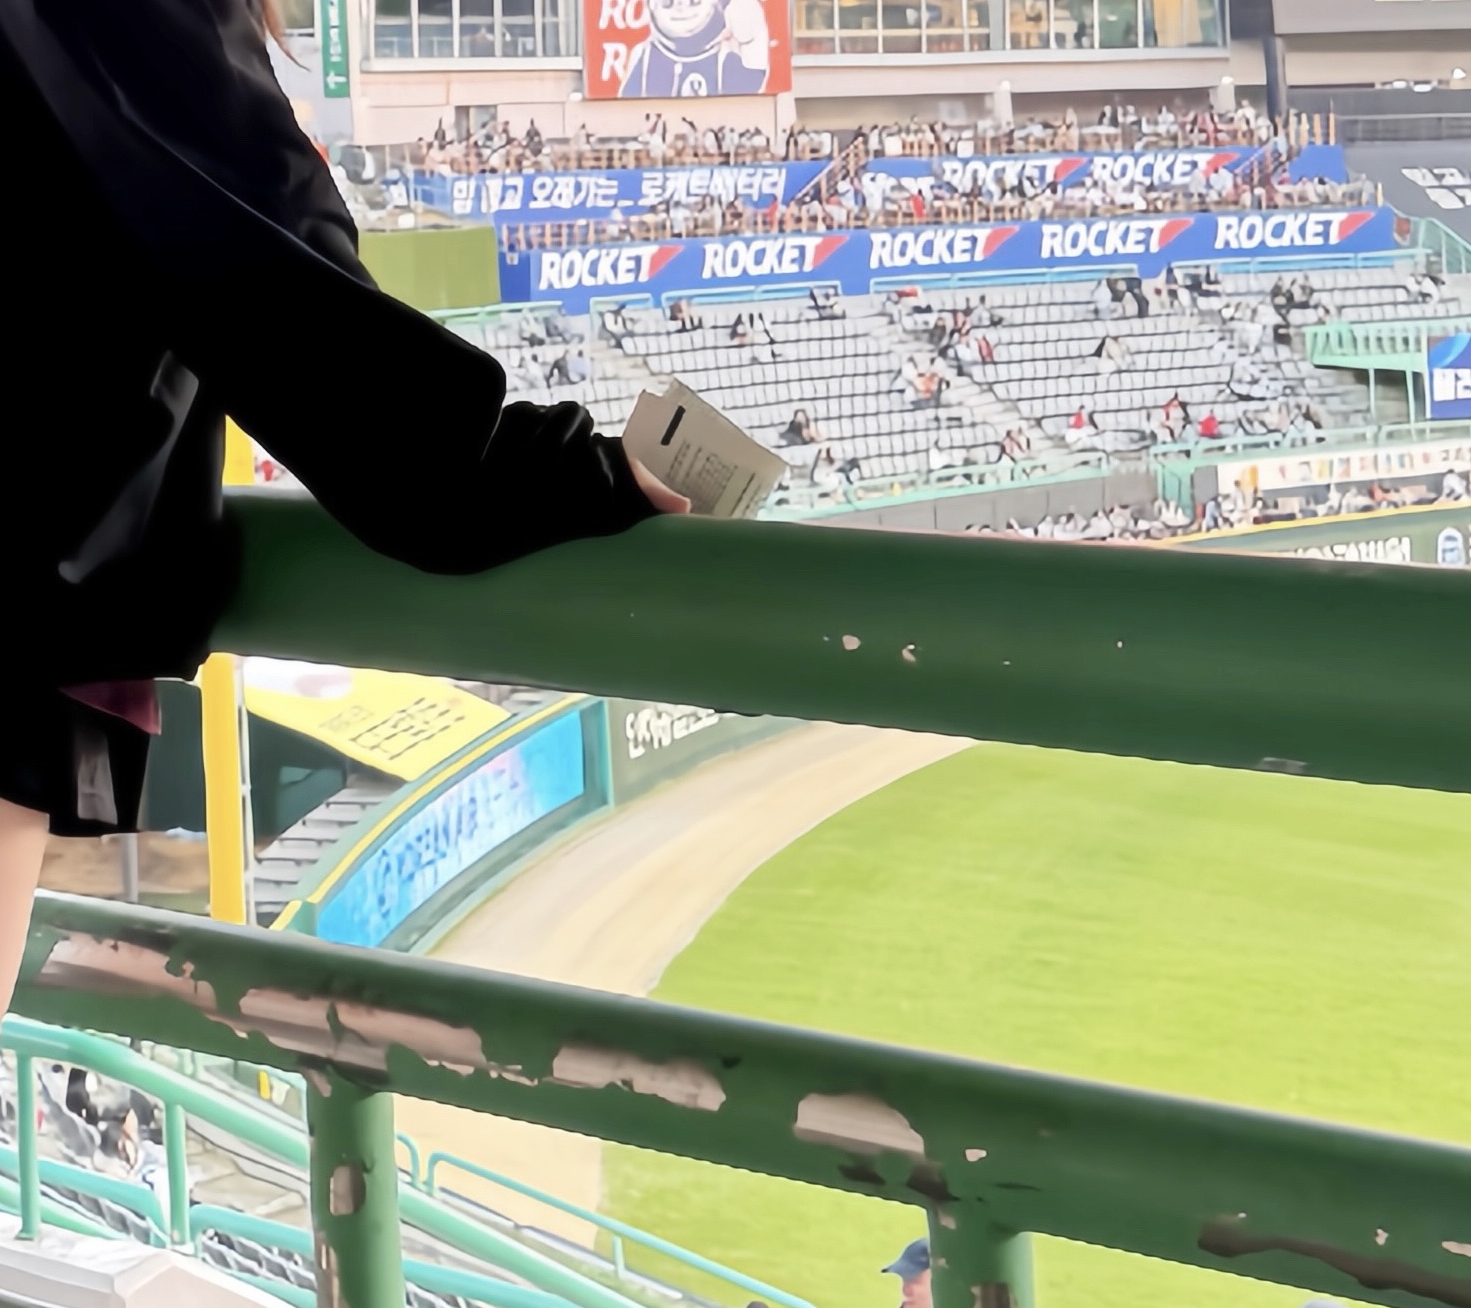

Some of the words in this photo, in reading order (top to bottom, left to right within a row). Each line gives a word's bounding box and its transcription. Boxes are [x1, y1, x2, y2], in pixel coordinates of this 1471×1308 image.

[1092, 152, 1220, 187] ROCKET
[539, 245, 664, 290] ROCKET
[701, 235, 828, 279] ROCKET
[869, 226, 996, 269] ROCKET
[1040, 219, 1168, 259] ROCKET
[1214, 211, 1350, 250] ROCKET
